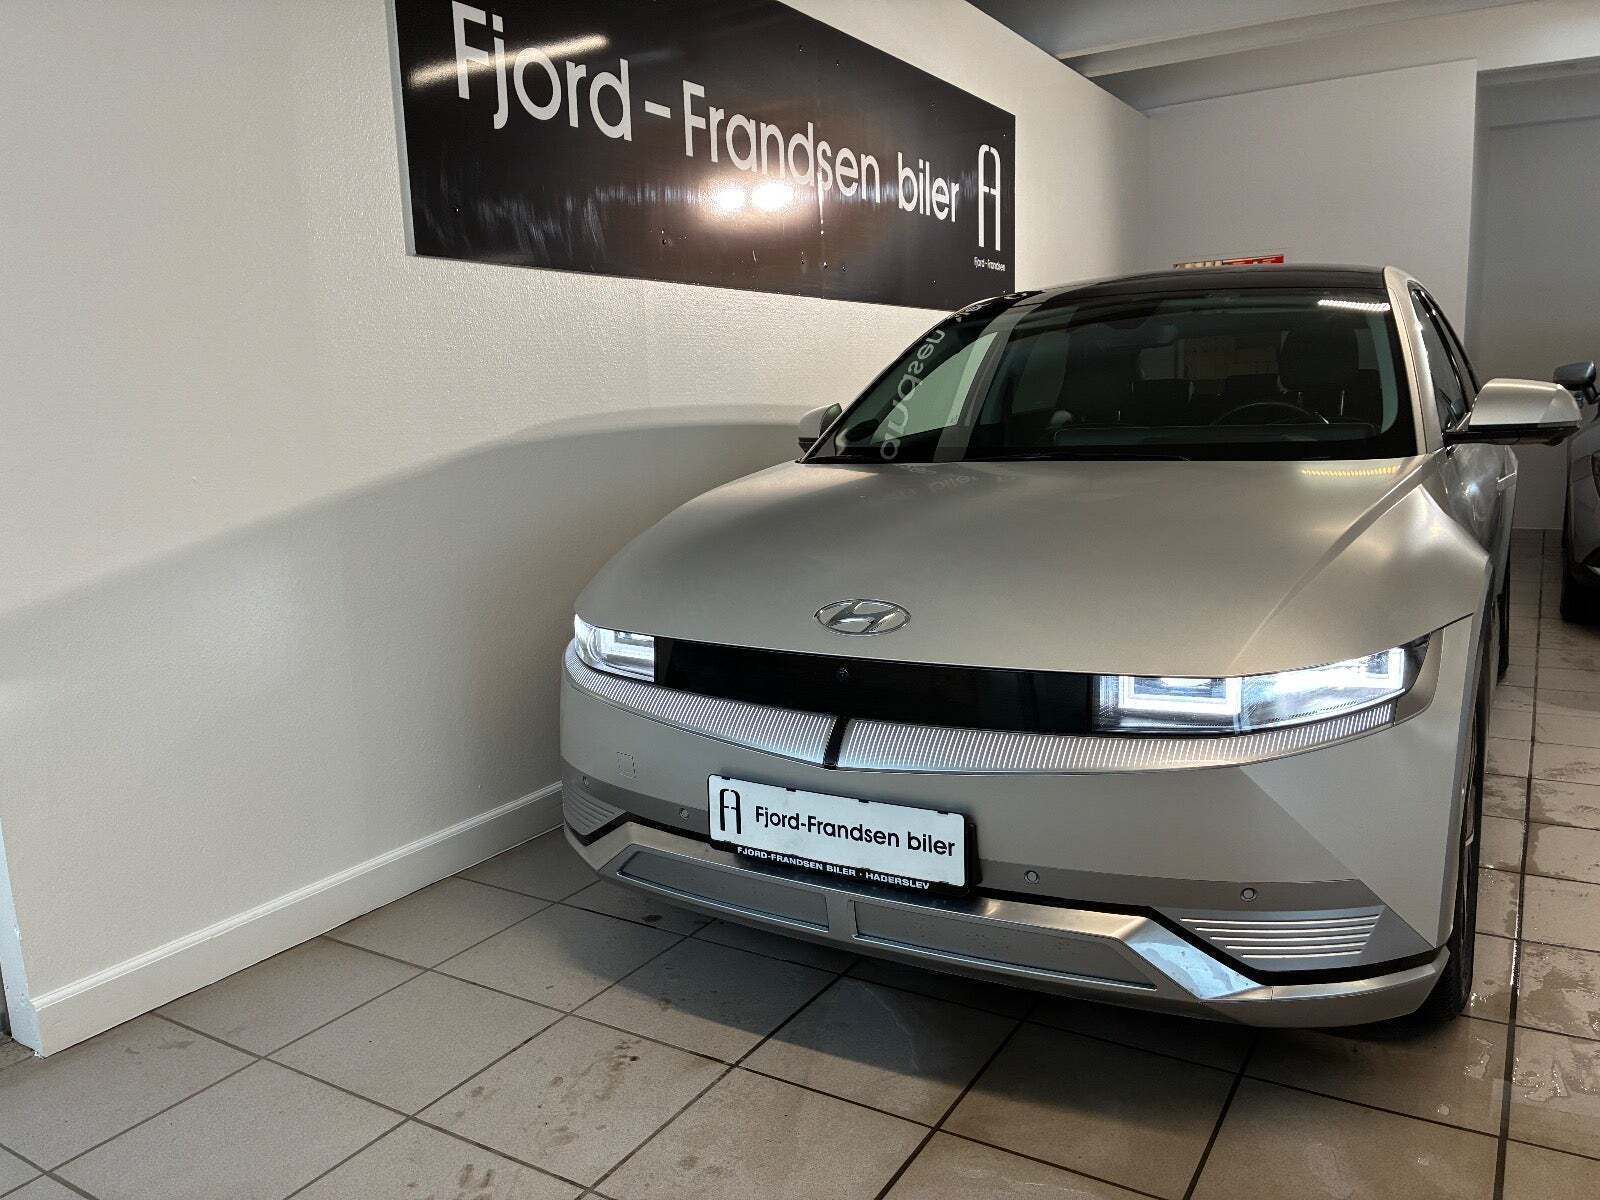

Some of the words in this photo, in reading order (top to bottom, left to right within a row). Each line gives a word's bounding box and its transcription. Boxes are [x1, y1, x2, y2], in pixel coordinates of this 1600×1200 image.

[898, 152, 960, 223] biler
[755, 806, 900, 848] Fjord-Frandsen
[907, 831, 956, 857] biler
[737, 846, 823, 871] FJORD-FRANDSEN
[826, 864, 856, 877] BILER
[865, 871, 930, 890] HADERSLEV
